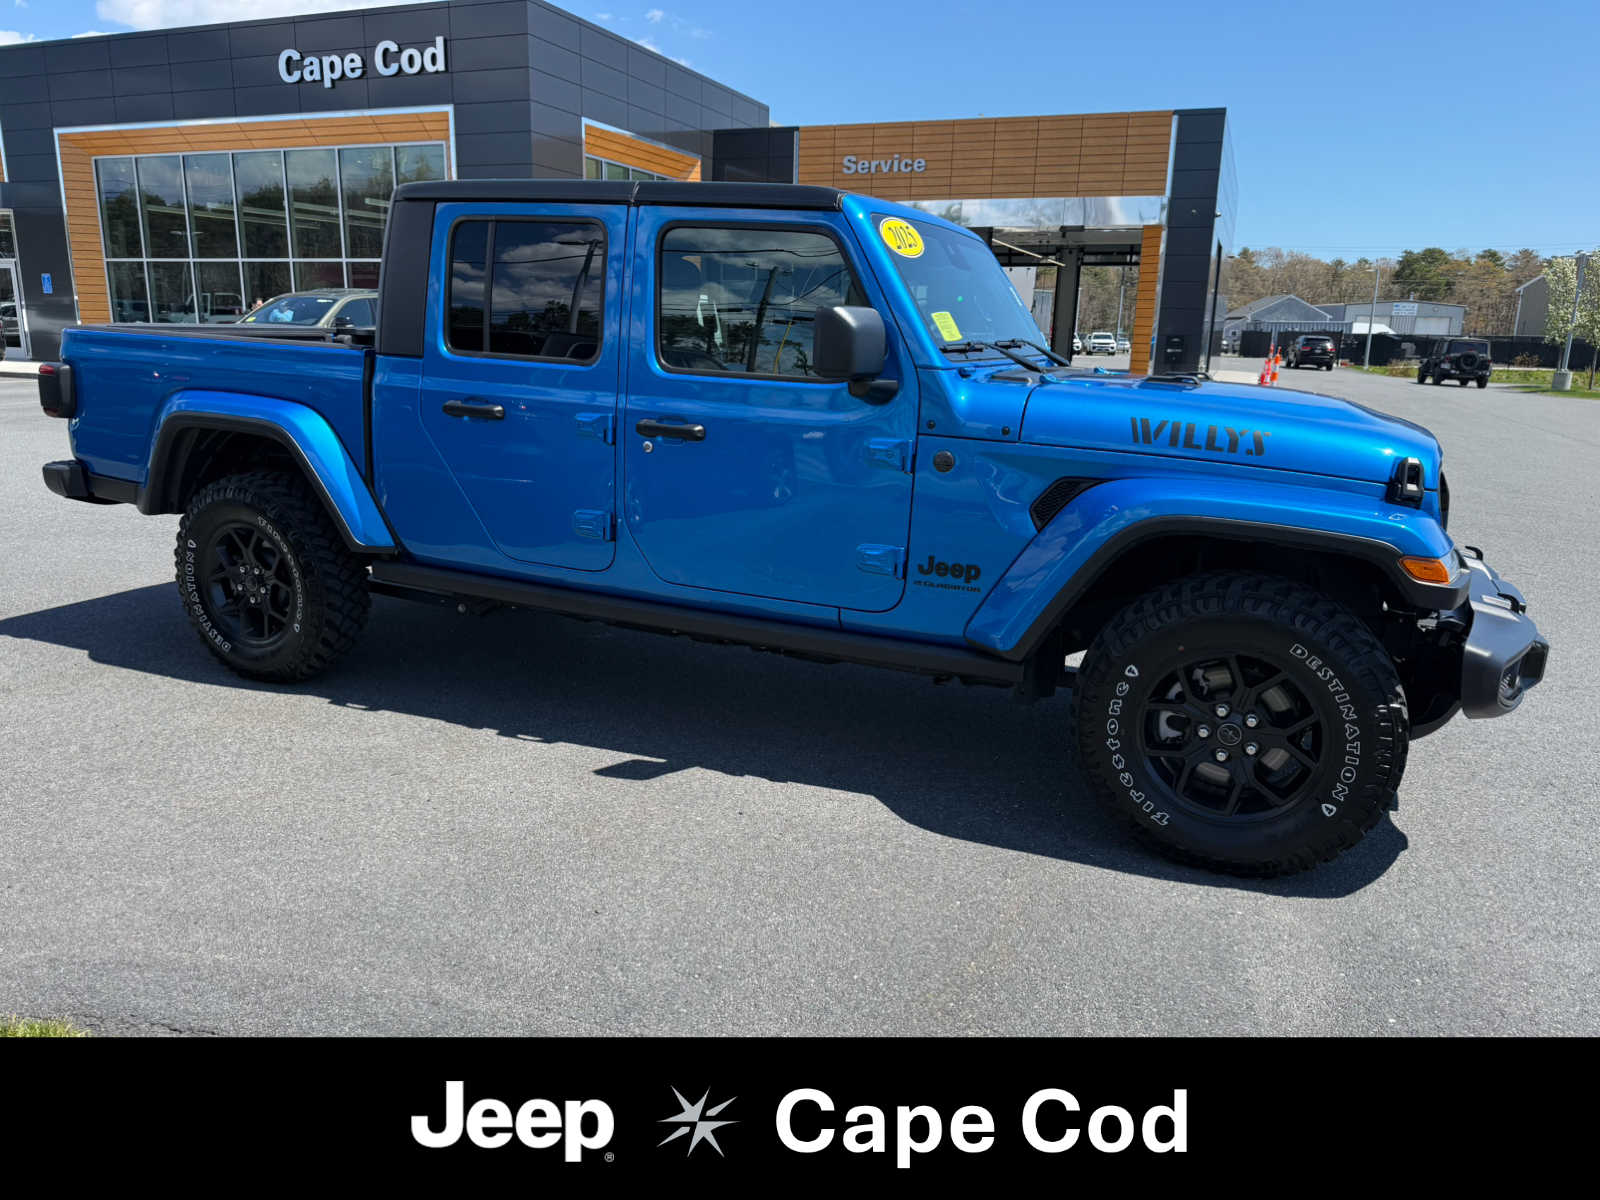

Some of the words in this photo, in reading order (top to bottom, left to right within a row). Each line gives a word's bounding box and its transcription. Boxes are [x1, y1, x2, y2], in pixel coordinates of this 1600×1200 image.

[278, 48, 364, 89] Cape
[374, 35, 447, 77] Cod
[842, 154, 926, 174] Service
[888, 225, 918, 250] 2025
[1130, 416, 1272, 457] WILLYS
[918, 555, 981, 583] Jeep
[1290, 643, 1361, 802] DESTINATION
[1106, 681, 1170, 827] Firestone
